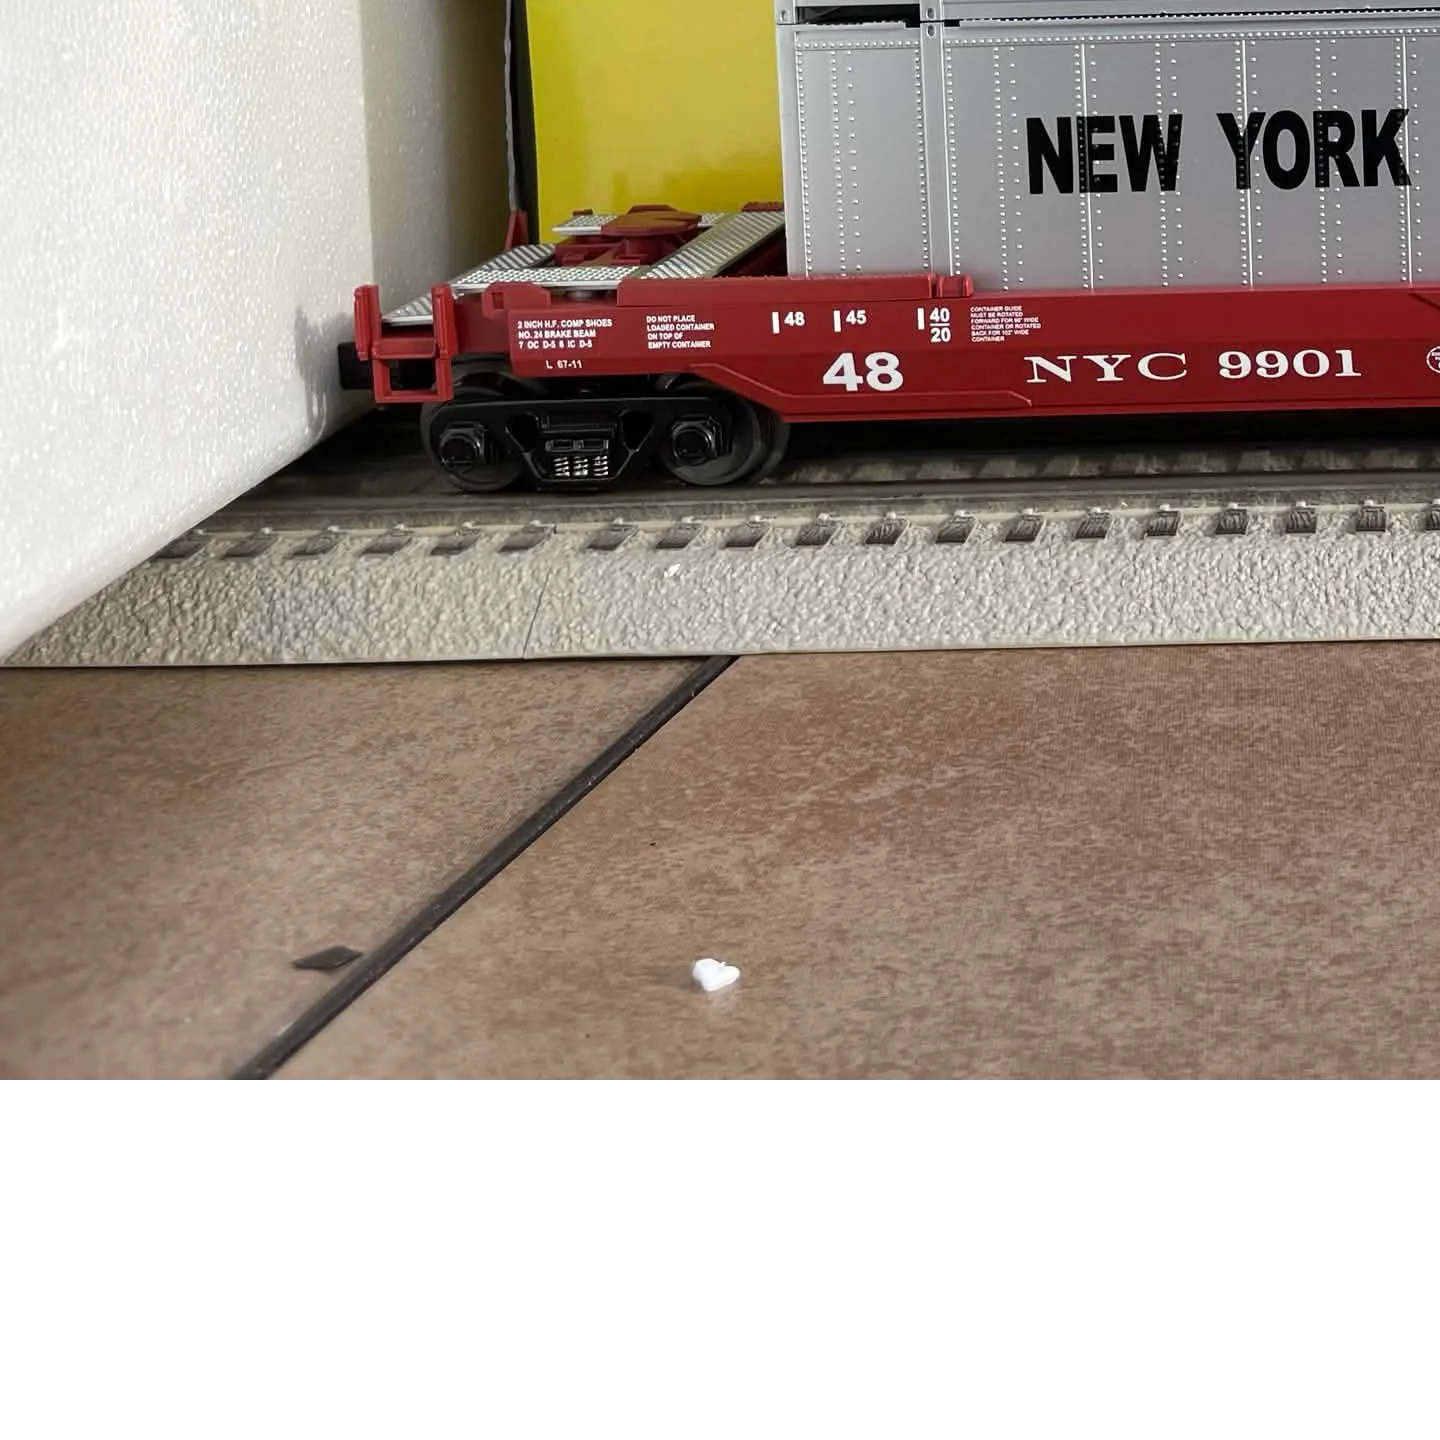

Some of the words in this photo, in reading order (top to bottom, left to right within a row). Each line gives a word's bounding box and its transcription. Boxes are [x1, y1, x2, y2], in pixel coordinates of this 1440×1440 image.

[1027, 113, 1183, 196] NEW
[1215, 107, 1412, 192] YORK
[647, 315, 656, 323] DO
[658, 315, 671, 323] NOT
[673, 315, 695, 323] PLACE
[784, 311, 805, 326] 48
[846, 310, 867, 325] 45
[929, 308, 950, 322] 40
[524, 320, 543, 329] INCH
[562, 319, 584, 328] COMP
[585, 319, 613, 327] SHOES
[647, 324, 674, 332] LOADED
[676, 323, 715, 331] CONTAINER
[533, 331, 543, 339] 24
[545, 330, 573, 339] BRAKE
[575, 329, 596, 338] BEAM
[648, 332, 658, 340] ON
[659, 332, 673, 340] TOP
[674, 332, 683, 340] OF
[930, 327, 951, 343] 20
[527, 340, 539, 349] OC
[568, 340, 575, 348] IC
[648, 341, 671, 349] EMPTY
[672, 340, 711, 348] CONTAINER
[546, 360, 552, 369] L
[557, 360, 582, 369] 67-11
[1025, 352, 1188, 383] NYC
[1218, 349, 1362, 378] 9901
[822, 351, 904, 392] 48
